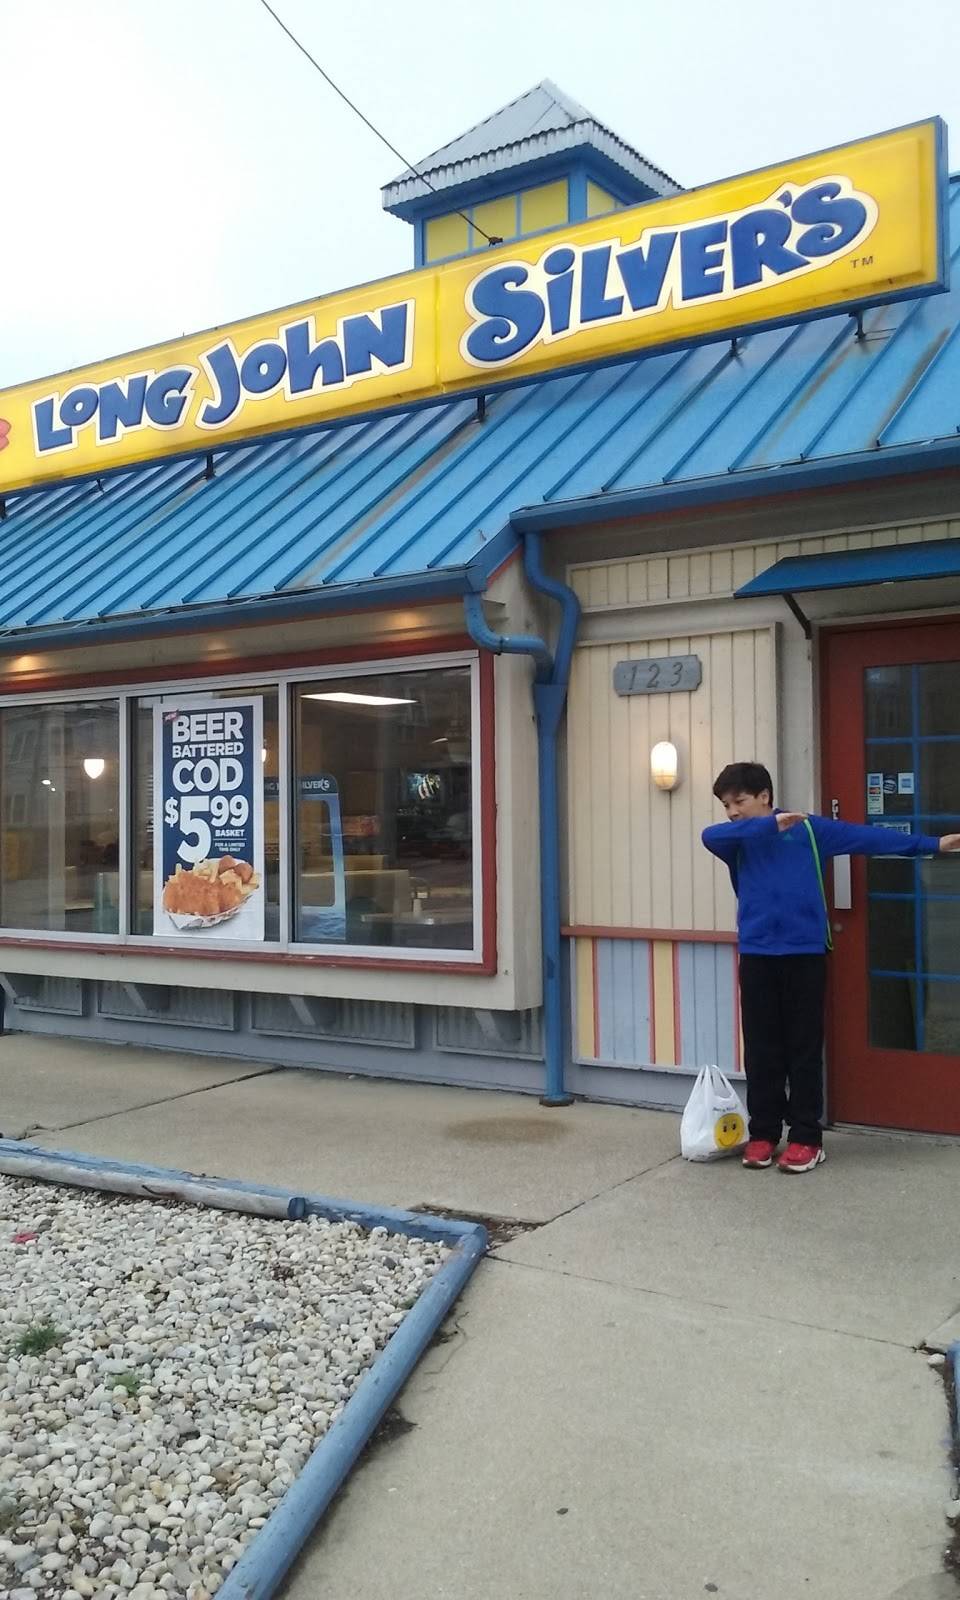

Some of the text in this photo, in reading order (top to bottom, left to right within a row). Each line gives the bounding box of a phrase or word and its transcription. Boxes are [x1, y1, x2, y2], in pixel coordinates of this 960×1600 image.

[850, 255, 874, 268] TM
[628, 661, 684, 691] 123
[172, 711, 244, 743] BEER
[172, 741, 245, 758] BATTERED
[172, 757, 244, 793] COD
[215, 829, 245, 837] BASKET
